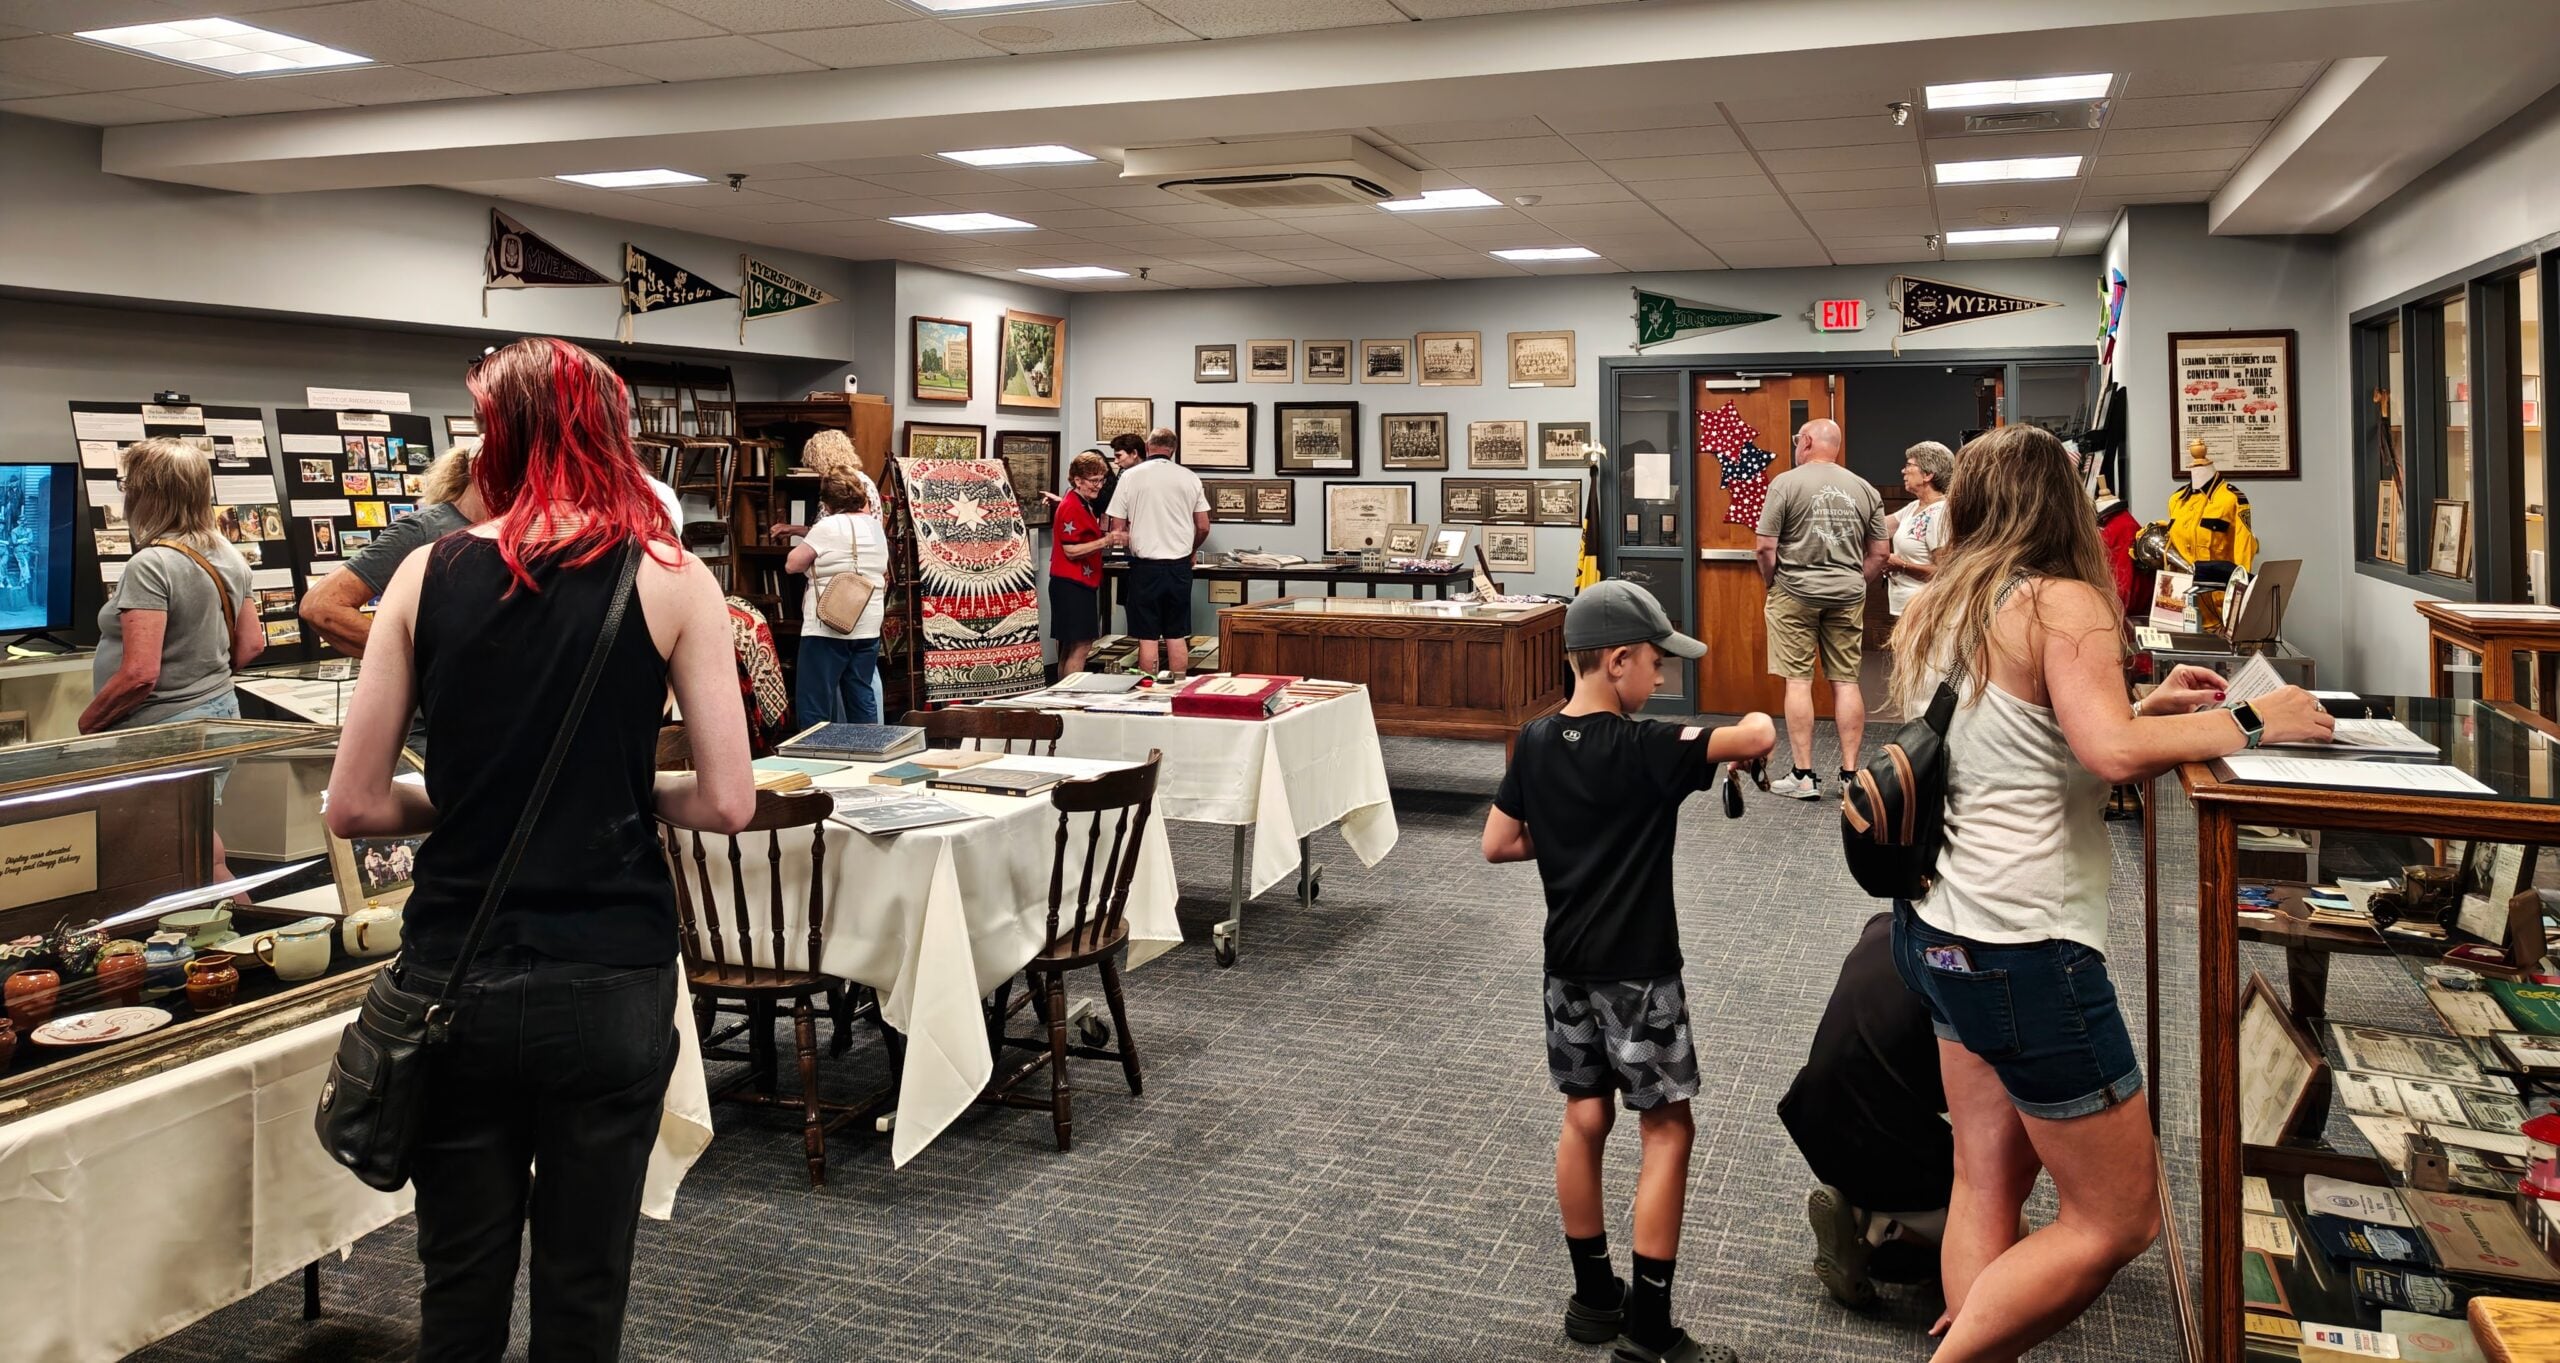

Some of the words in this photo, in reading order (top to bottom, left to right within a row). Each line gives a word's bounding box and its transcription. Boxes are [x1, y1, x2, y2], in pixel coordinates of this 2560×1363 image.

[750, 259, 809, 295] MYERSTOWN
[750, 280, 764, 310] 19
[782, 291, 797, 308] 49
[1945, 293, 2038, 315] MYERSTOWN
[1823, 301, 1860, 328] EXIT
[2181, 357, 2206, 366] LEBANON
[2208, 356, 2229, 366] COUNTY
[2231, 355, 2260, 365] FIREMEN'S
[2262, 355, 2278, 364] ASSO.
[2187, 369, 2230, 380] CONVENTION
[2245, 368, 2273, 378] PARADE
[2237, 379, 2269, 387] SATURDAY,
[2252, 387, 2267, 395] JUNE
[2227, 403, 2237, 412] PA.
[2188, 416, 2198, 425] THE
[2201, 415, 2230, 425] GOODWILL
[2232, 415, 2246, 424] FIRE
[2248, 415, 2258, 424] CO.
[2260, 415, 2271, 424] NO.
[1812, 508, 1856, 516] MYERSTOWN
[5, 854, 29, 865] Display
[30, 851, 45, 859] case
[45, 844, 72, 857] donated
[4, 866, 22, 876] Doug
[22, 860, 37, 871] and
